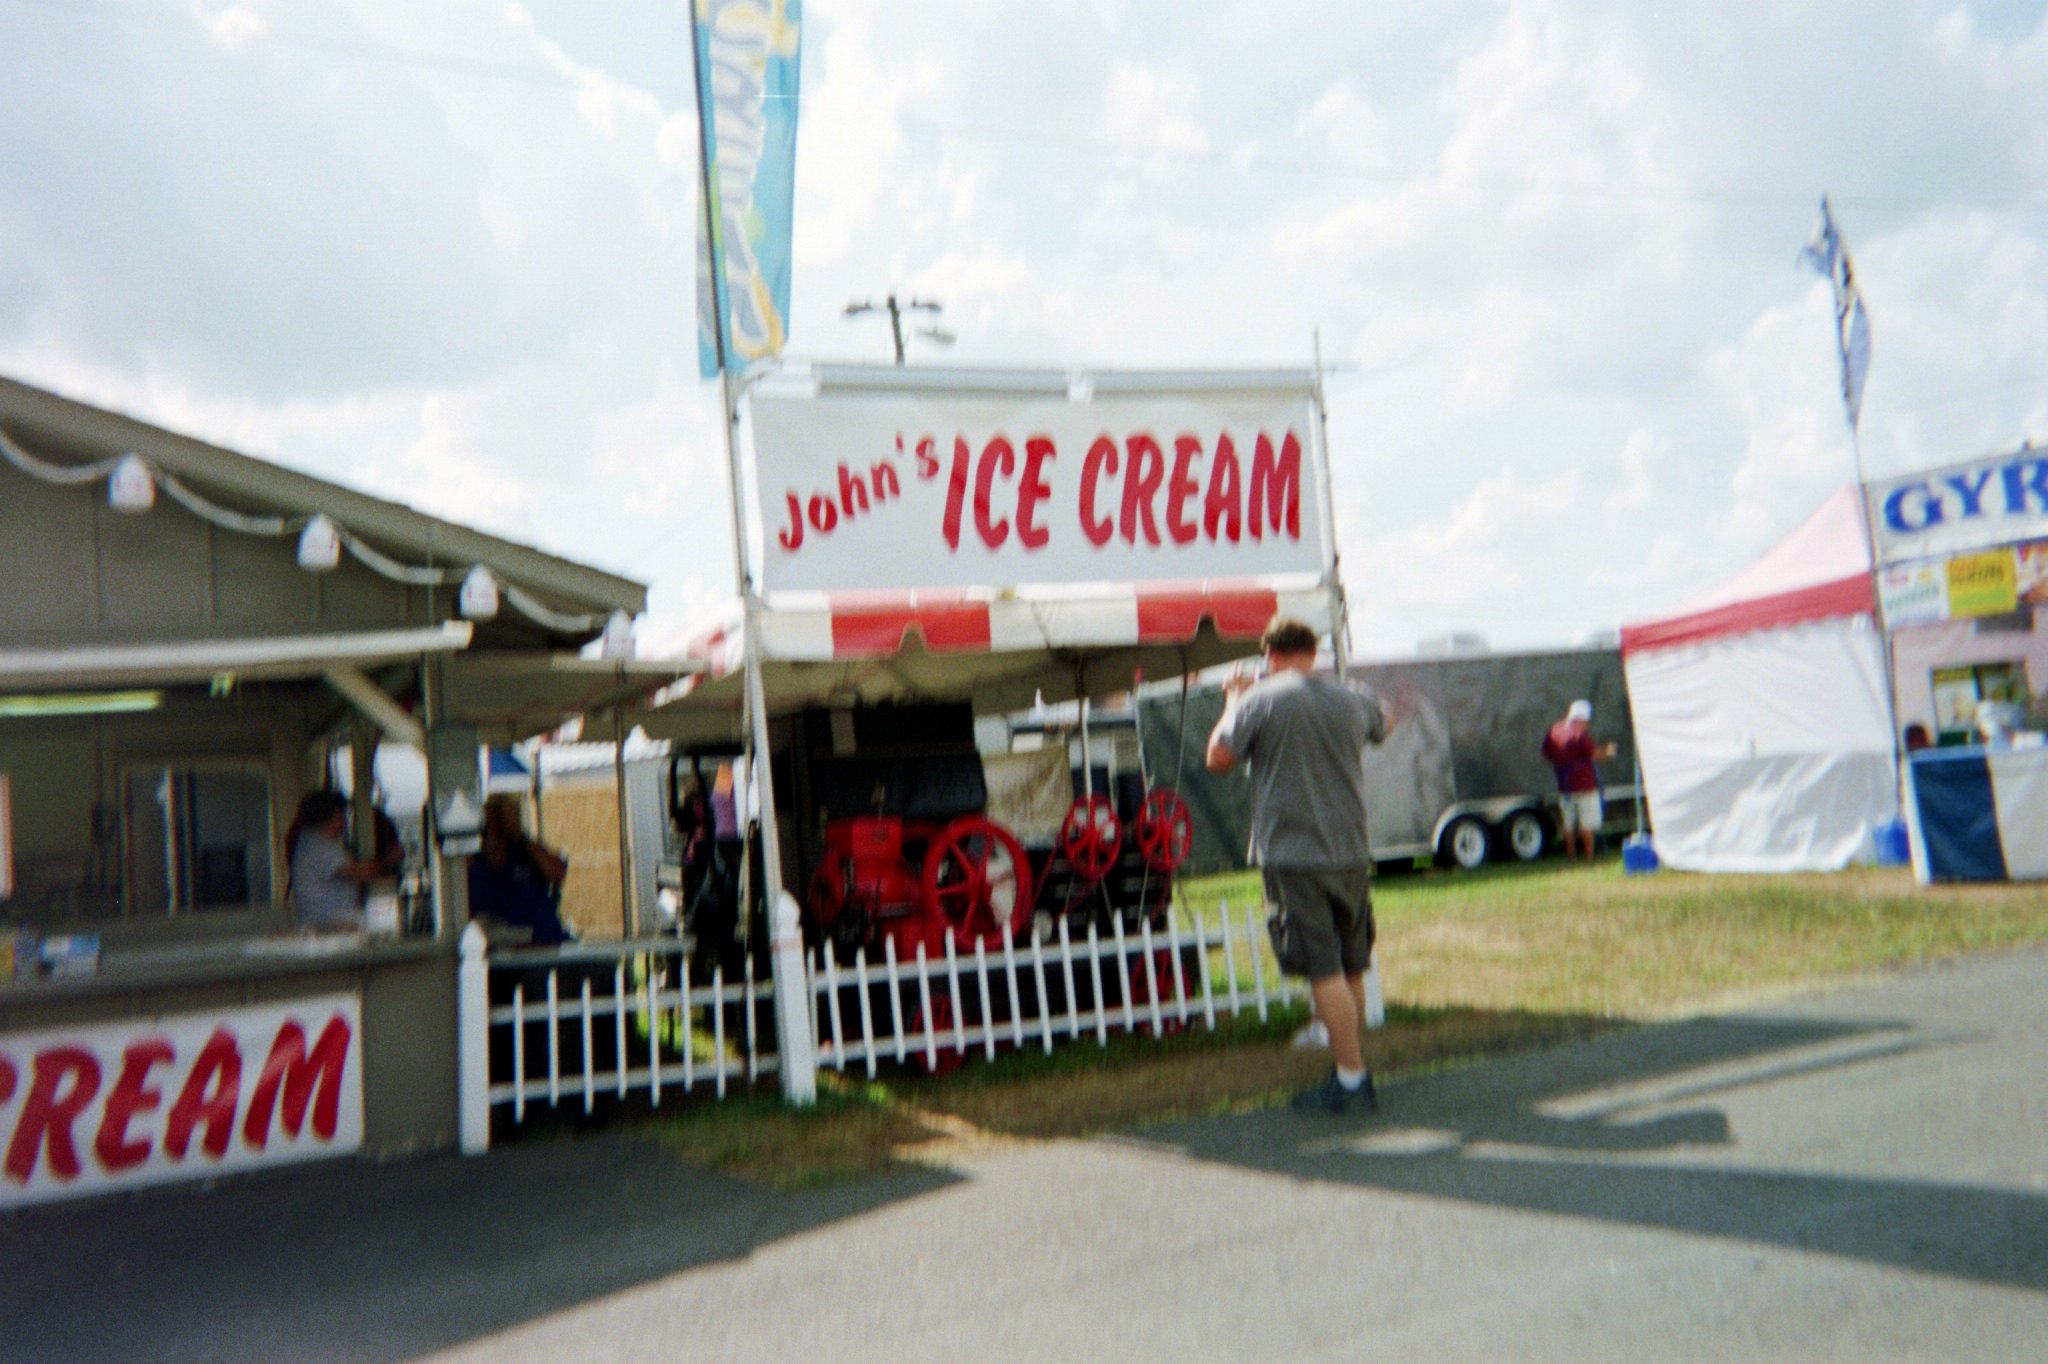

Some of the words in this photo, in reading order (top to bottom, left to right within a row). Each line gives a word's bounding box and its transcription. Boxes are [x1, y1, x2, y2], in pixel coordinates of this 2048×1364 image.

[779, 431, 940, 552] John's
[942, 434, 1057, 552] ICE
[1078, 430, 1302, 550] CREAM
